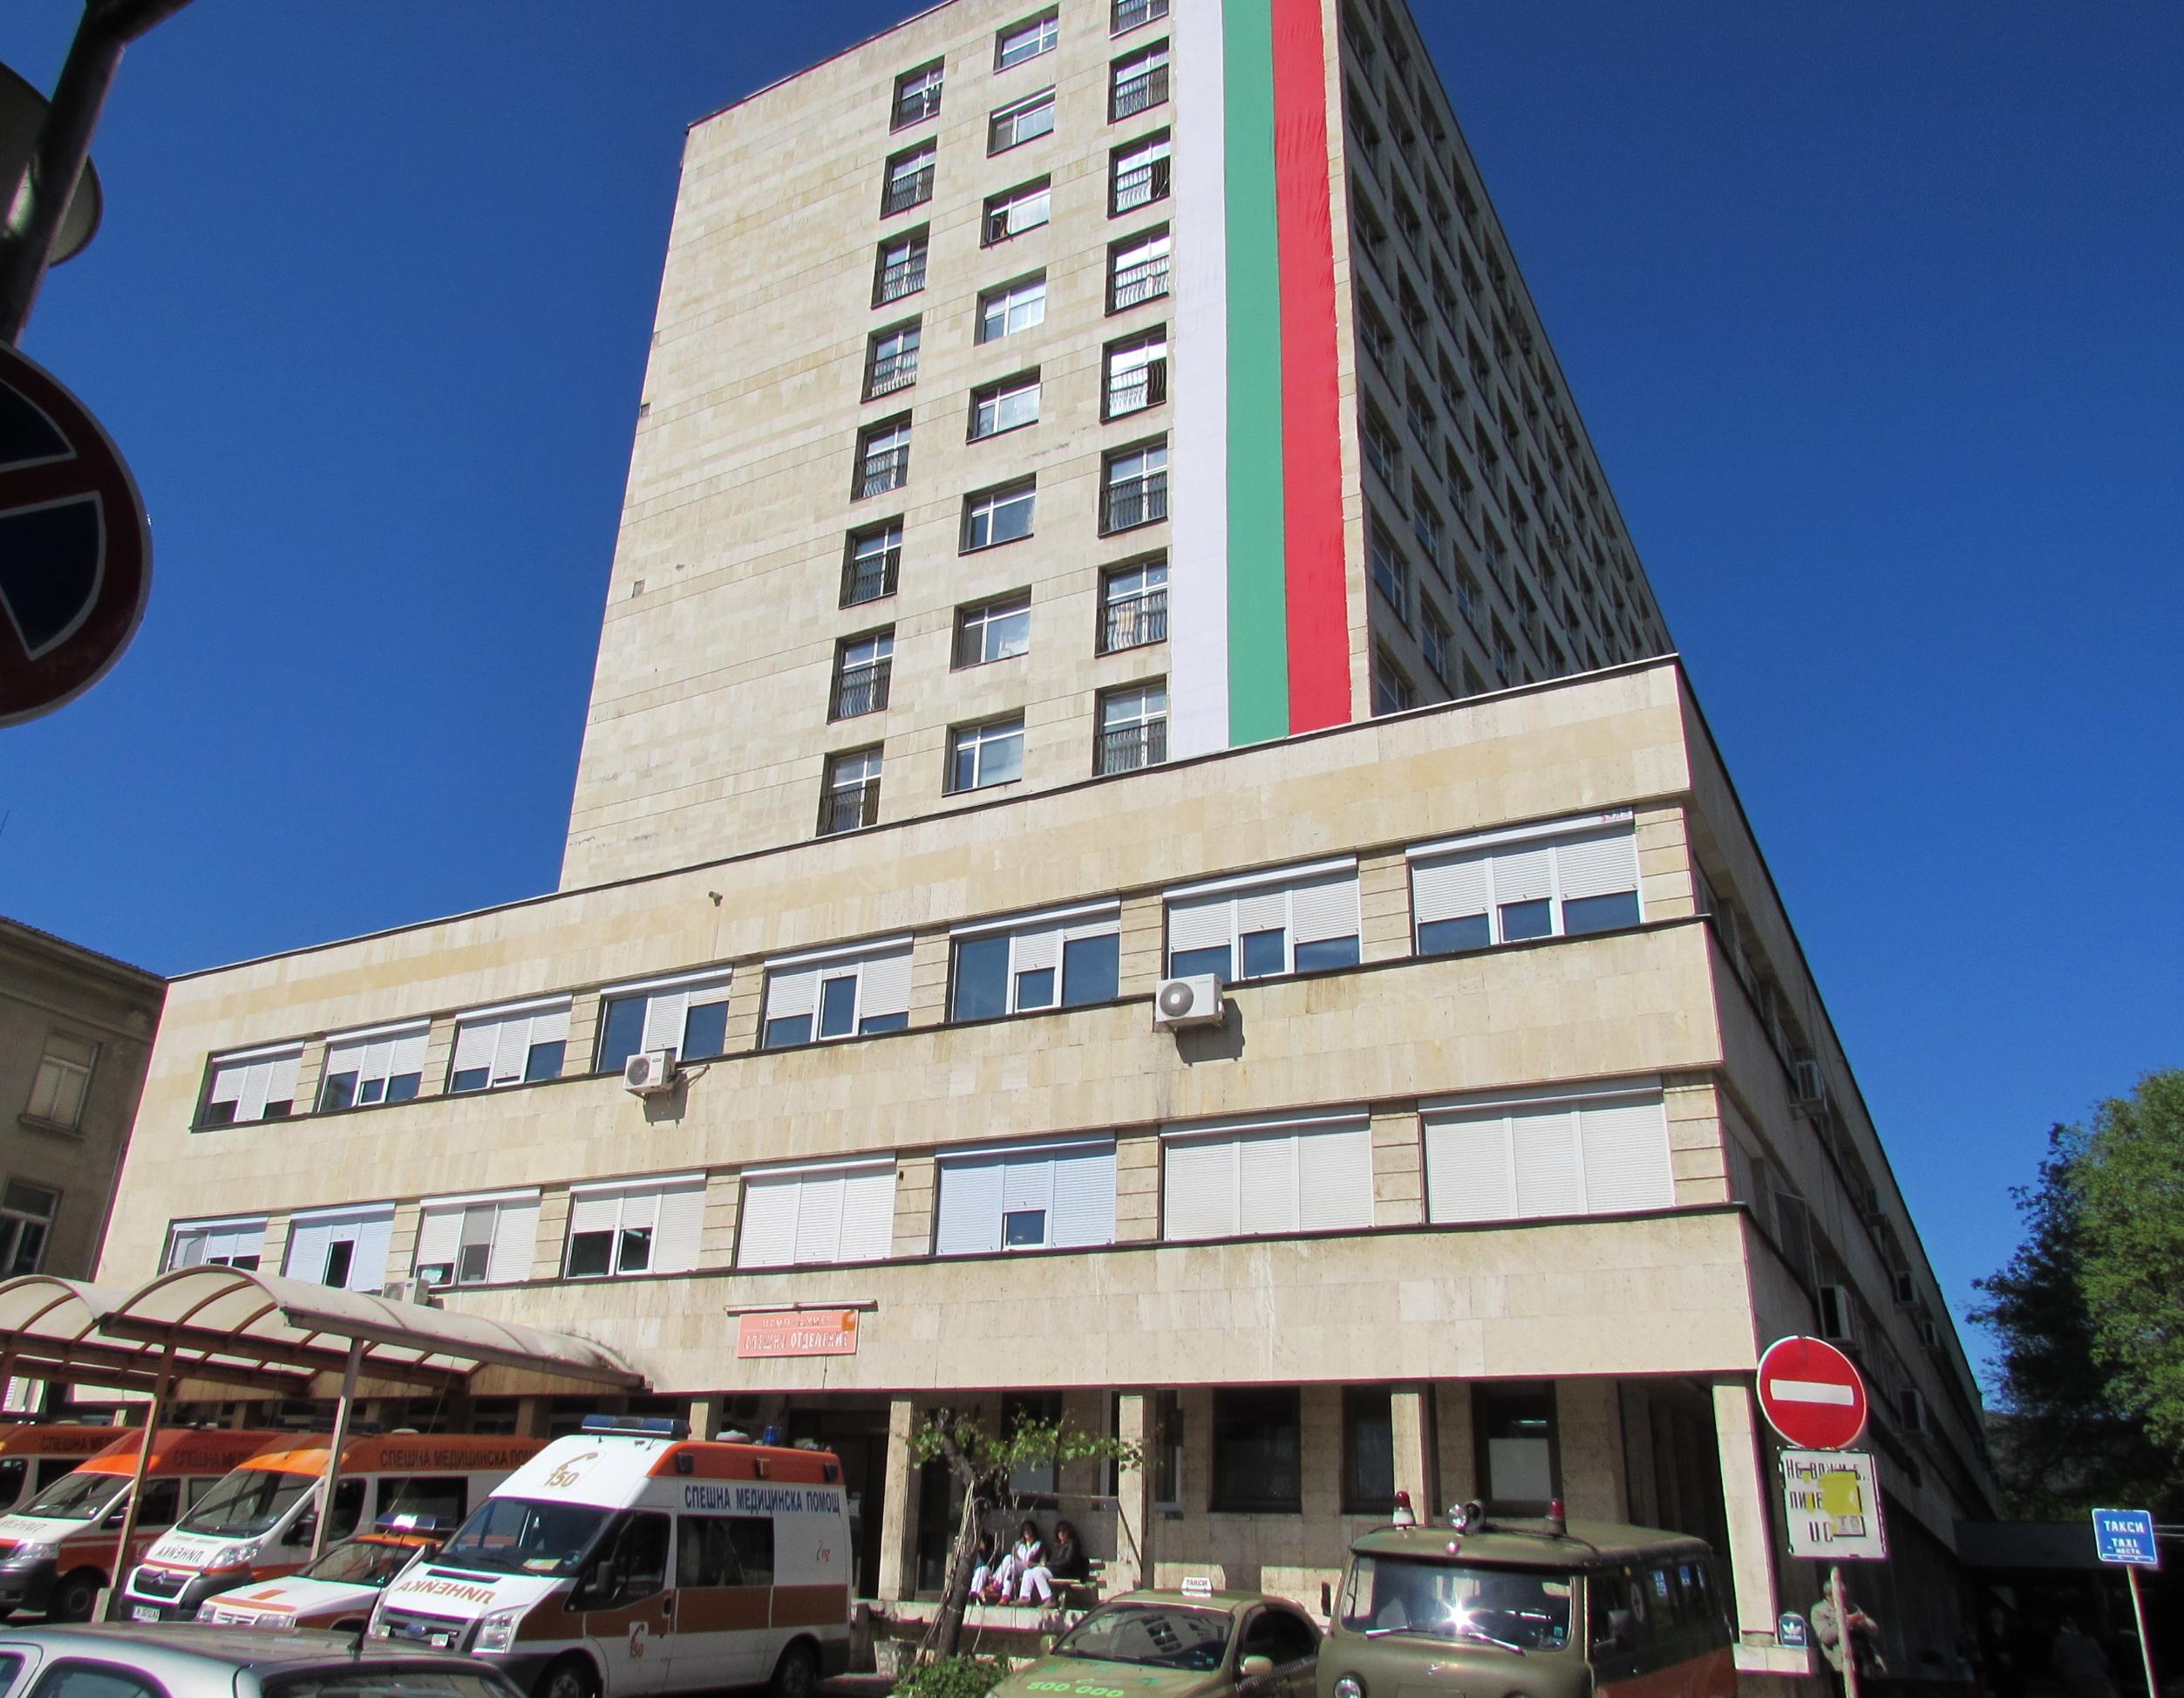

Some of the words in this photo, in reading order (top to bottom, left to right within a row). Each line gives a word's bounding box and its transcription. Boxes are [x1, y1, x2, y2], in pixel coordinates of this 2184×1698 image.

[790, 1331, 849, 1349] ОТДЕЛЕНИЕ
[380, 1449, 431, 1467] СПЕШНА
[434, 1449, 507, 1470] МЕДИЦИНСКА
[544, 1470, 580, 1488] 150
[684, 1485, 731, 1509] СПЕШНА
[736, 1488, 803, 1516] МЕДИЦИНСКА
[806, 1491, 840, 1517] ПОМОЩ
[2103, 1521, 2145, 1533] ТАКСИ
[2111, 1538, 2138, 1548] TAXI
